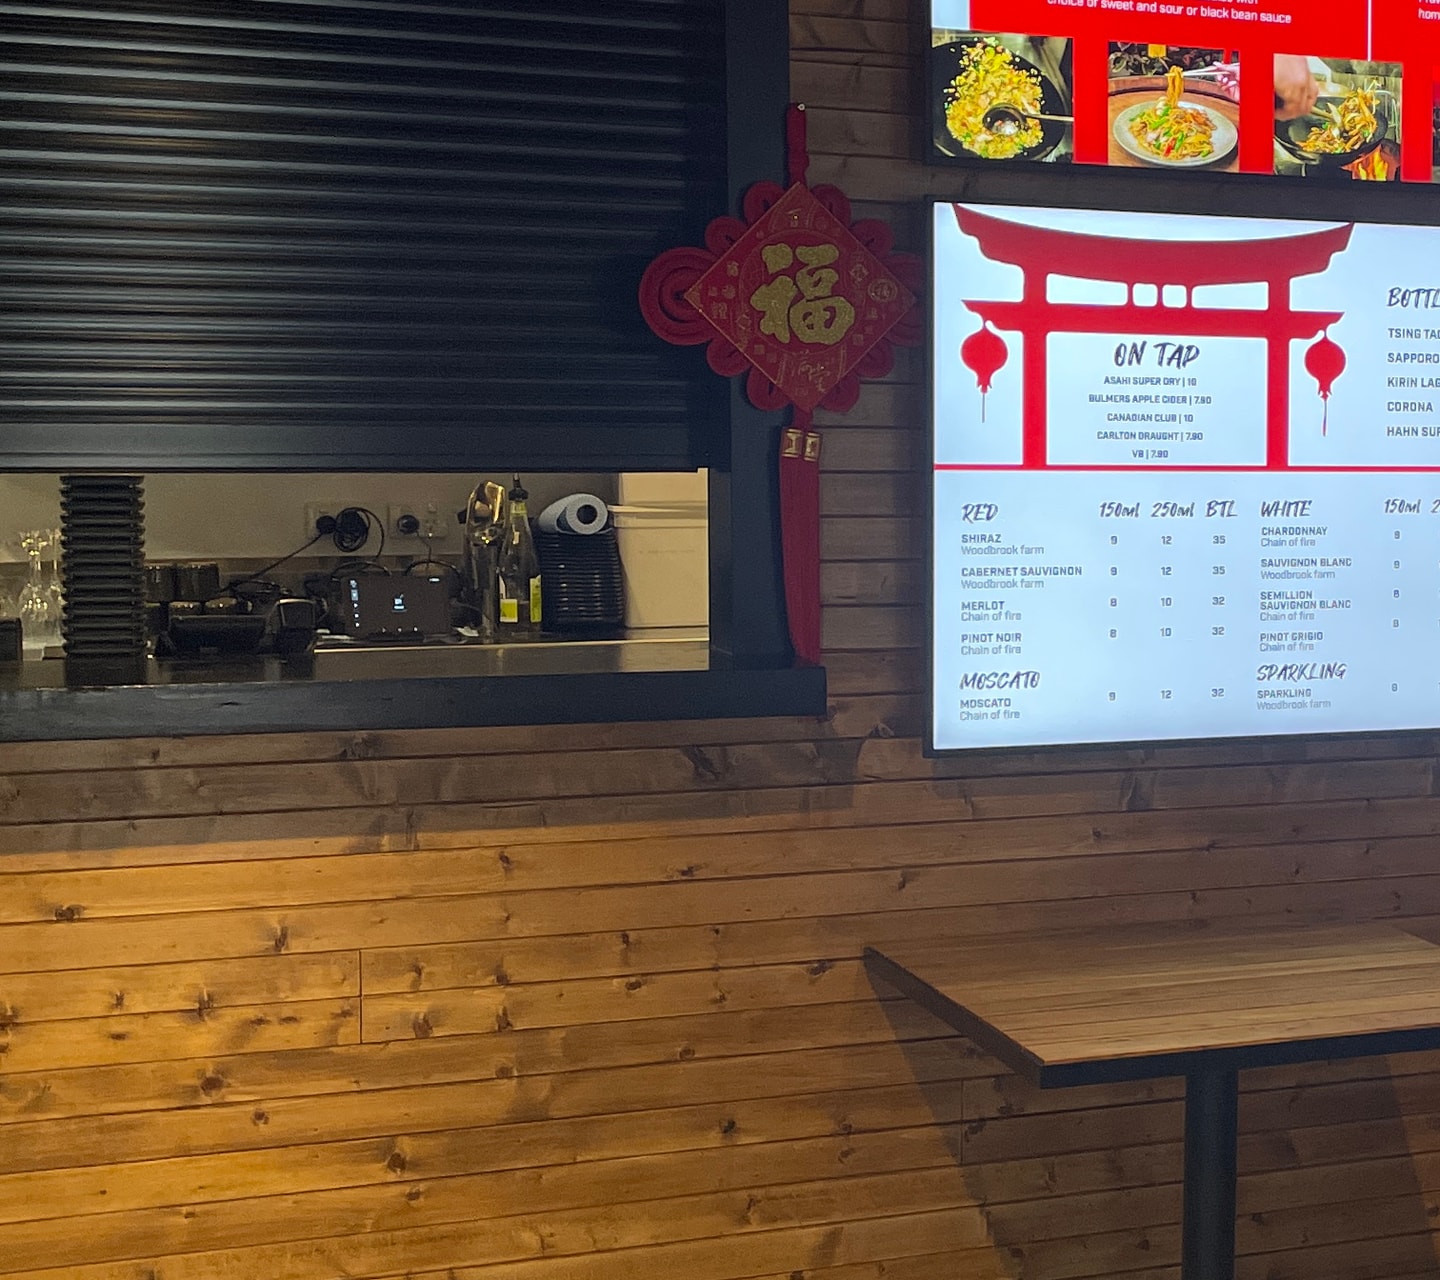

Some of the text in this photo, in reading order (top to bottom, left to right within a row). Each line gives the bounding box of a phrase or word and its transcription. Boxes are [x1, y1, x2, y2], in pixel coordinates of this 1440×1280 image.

[750, 243, 855, 345] 福
[1387, 327, 1421, 339] TSING
[1114, 340, 1200, 369] ON TAP
[1387, 352, 1440, 364] SAPPORO
[1103, 375, 1197, 386] ASAHI SUPER DRY 10
[1387, 376, 1417, 388] KIRIN
[1088, 393, 1130, 403] BULMERS
[1131, 394, 1160, 403] APPLE
[1161, 395, 1187, 404] CIDER
[1387, 401, 1433, 412] CORONA
[1106, 412, 1194, 422] CANADIAN CLUB 10
[1097, 431, 1137, 440] CARLTON
[1137, 431, 1179, 440] DRAUGHT
[1386, 426, 1418, 437] HAHN
[962, 499, 1237, 524] RED 150ml 250ml BTL
[1260, 499, 1312, 517] WHITE
[1384, 498, 1421, 513] 150ml
[1261, 526, 1327, 536] CHARDONNAY
[961, 533, 1001, 543] SHIRAZ
[1161, 535, 1172, 545] 12
[1212, 535, 1226, 544] 35
[960, 544, 1044, 555] Woodbrook farm
[1260, 557, 1351, 567] SAUVIGNON BLANC
[961, 566, 1018, 577] CABERNET
[1020, 566, 1082, 576] SAUVIGNON
[1160, 566, 1172, 576] 12
[1212, 565, 1225, 575] 35
[1260, 590, 1312, 600] SEMILLION
[961, 600, 1005, 611] MERLOT
[1160, 596, 1172, 606] 10
[1212, 596, 1225, 605] 32
[1260, 599, 1351, 610] SAUVIGNON BLANC
[961, 633, 994, 643] PINOT
[995, 632, 1021, 642] NOIR
[1160, 627, 1172, 637] 10
[1211, 626, 1224, 635] 32
[1259, 631, 1323, 642] PINOT GRIGIO
[1256, 662, 1347, 682] SPARKLING
[959, 670, 1040, 690] MOSCATO
[1257, 688, 1311, 699] SPARKLING
[960, 697, 1011, 709] MOSCATO
